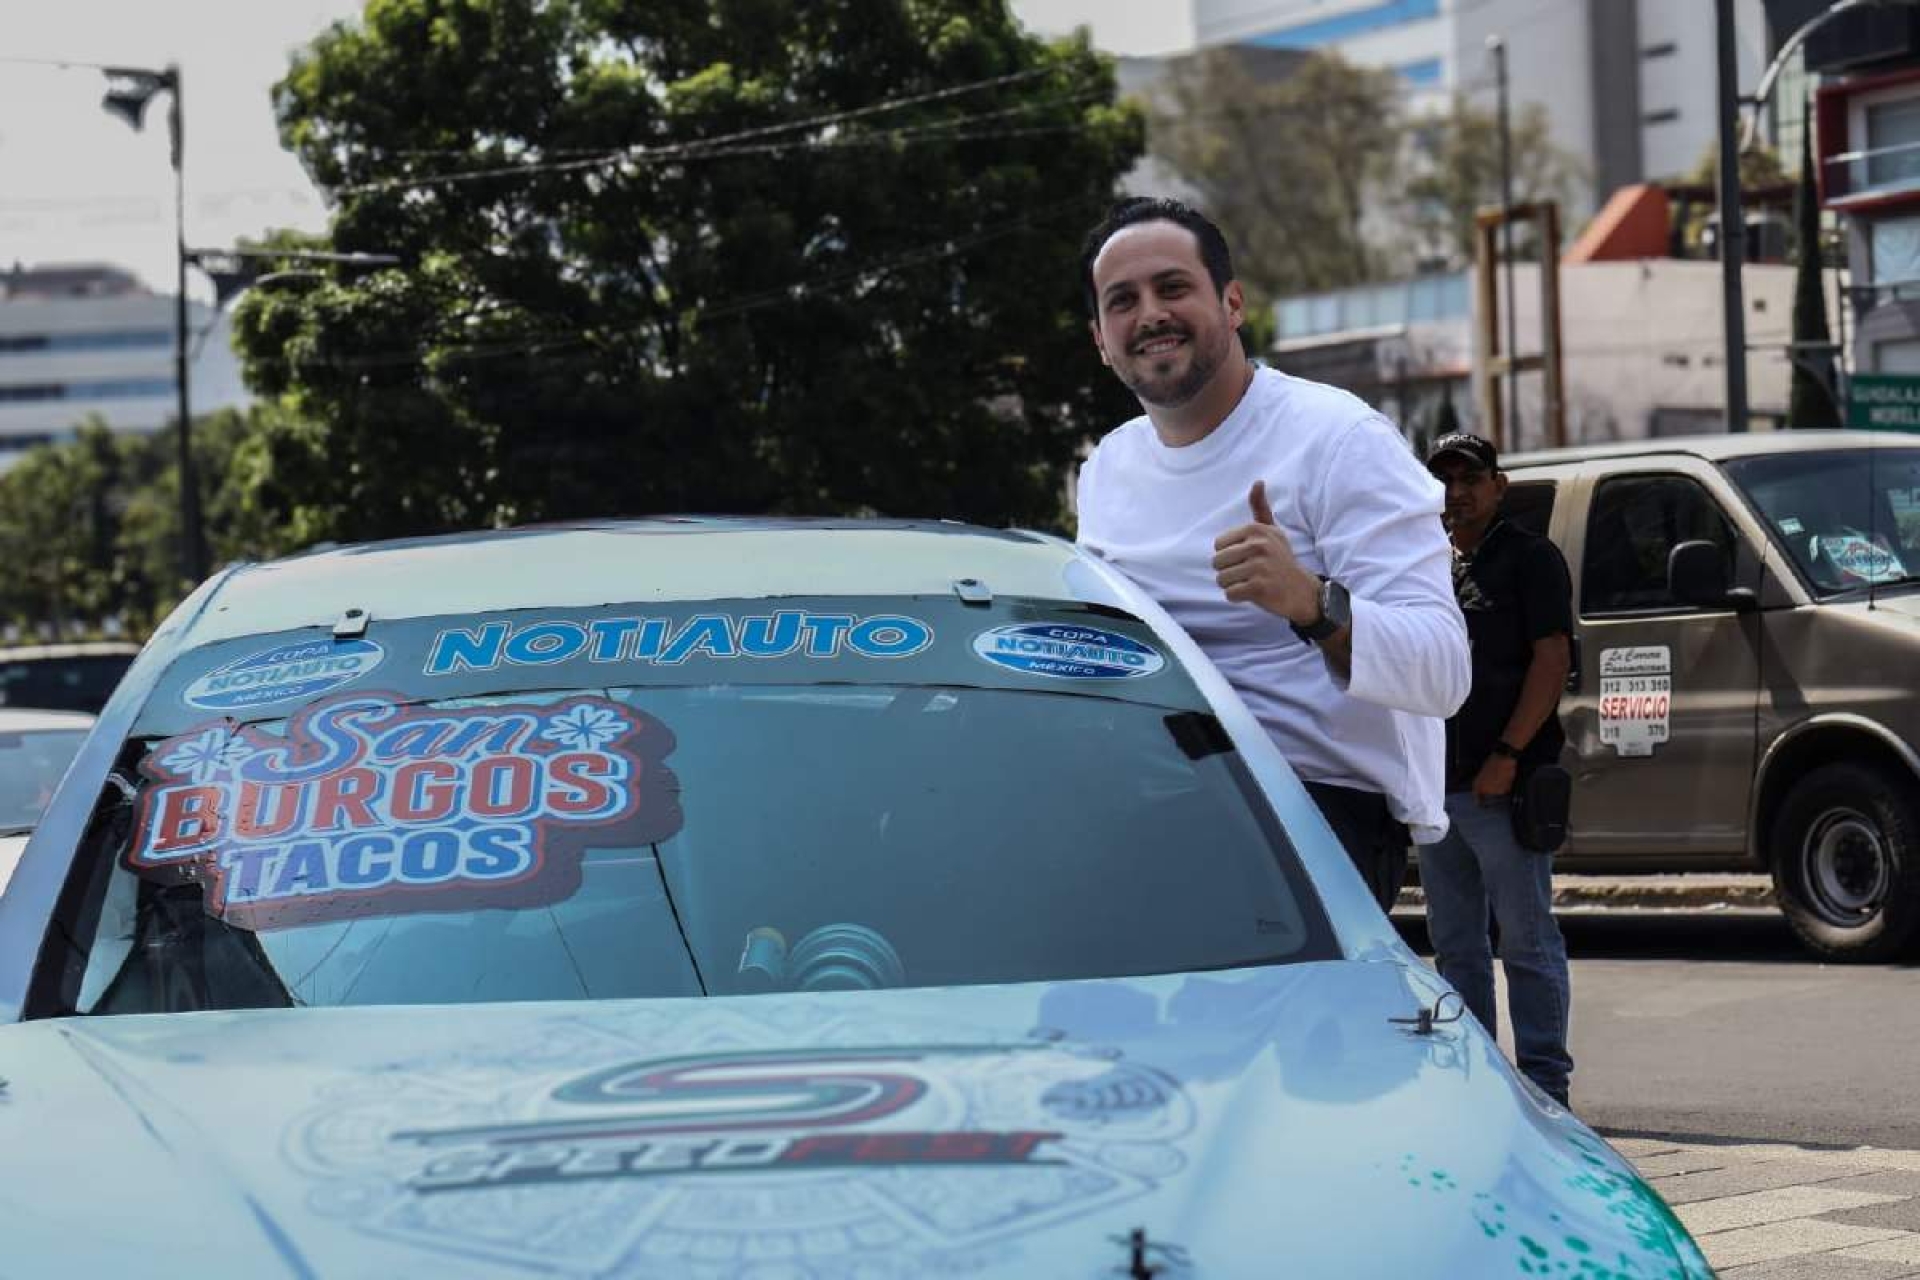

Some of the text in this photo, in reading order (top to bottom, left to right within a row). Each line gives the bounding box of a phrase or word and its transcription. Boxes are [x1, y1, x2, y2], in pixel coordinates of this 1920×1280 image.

[269, 645, 329, 662] COPA
[424, 610, 934, 674] NOTIAUTO
[995, 637, 1147, 666] NOTIAUTO
[1049, 629, 1108, 644] COPA
[208, 657, 362, 691] NOTIAUTO
[1602, 696, 1667, 719] SERVICIO
[238, 699, 540, 785] San
[146, 751, 622, 856] BURGOS
[227, 826, 531, 901] TACOS
